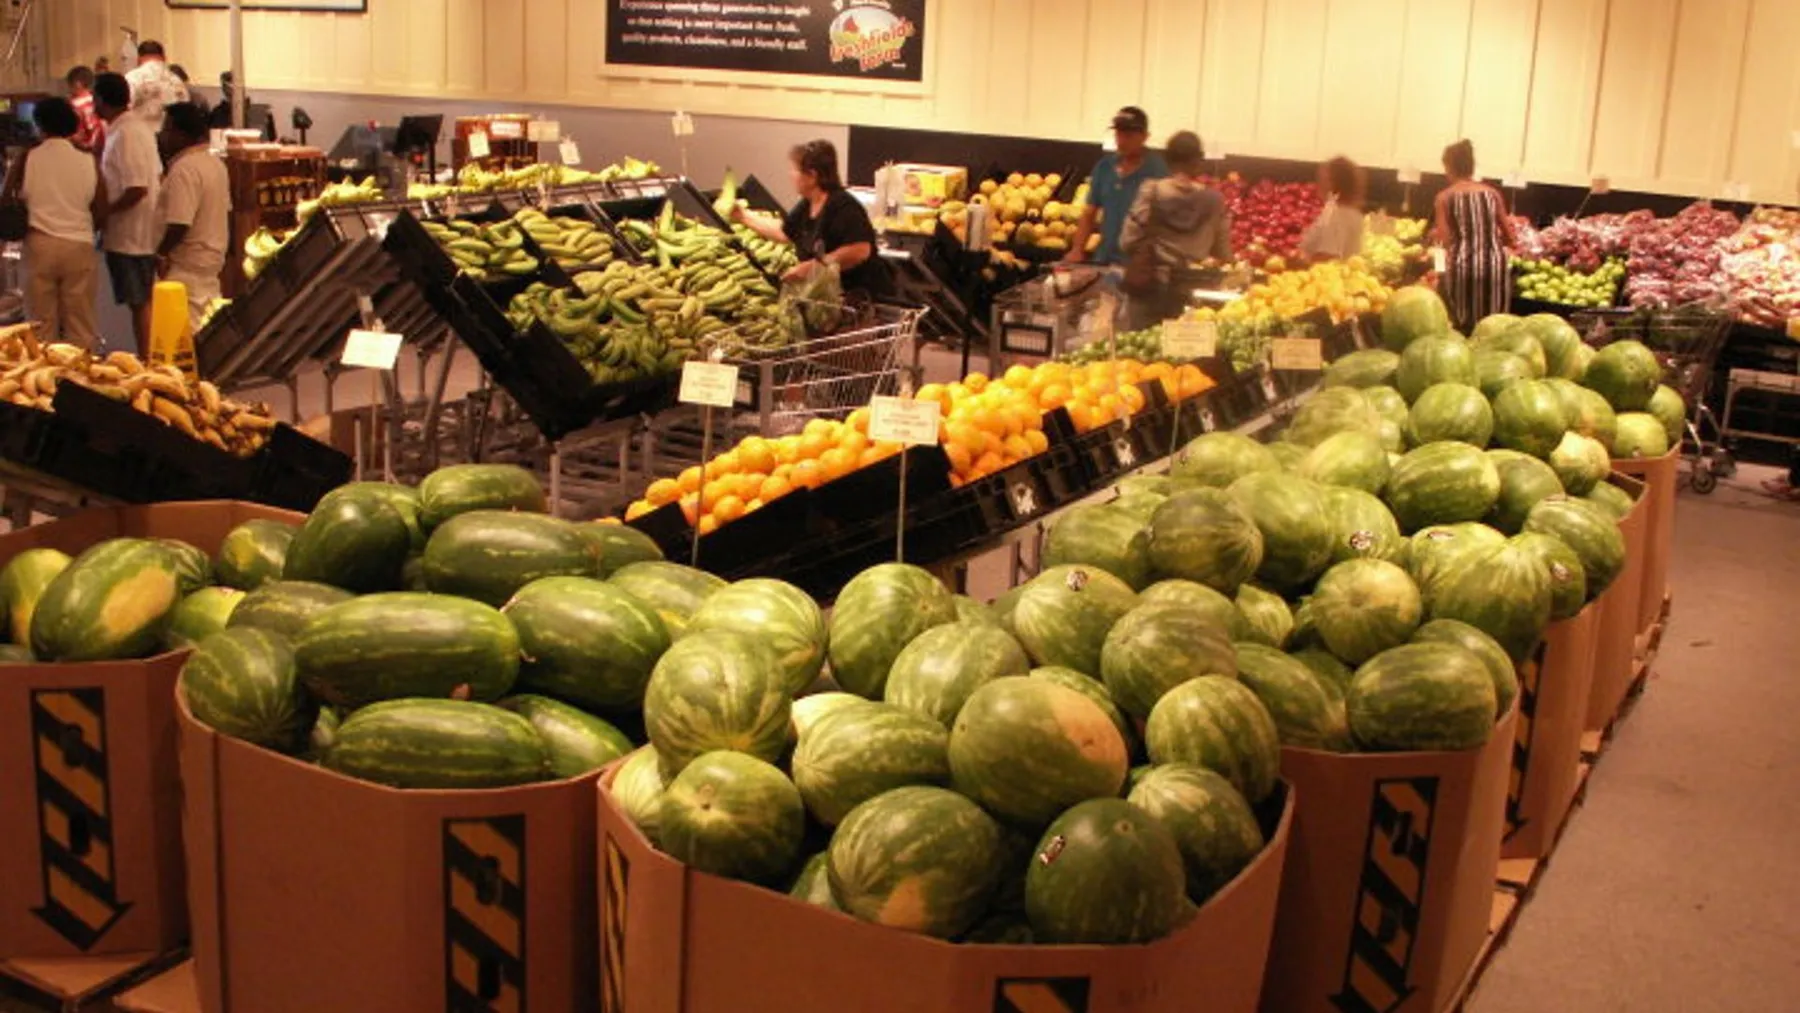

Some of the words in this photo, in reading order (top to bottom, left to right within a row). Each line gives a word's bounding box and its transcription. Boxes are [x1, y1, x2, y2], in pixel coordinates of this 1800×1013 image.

[785, 4, 811, 17] taught
[714, 18, 753, 32] important
[730, 37, 746, 48] and
